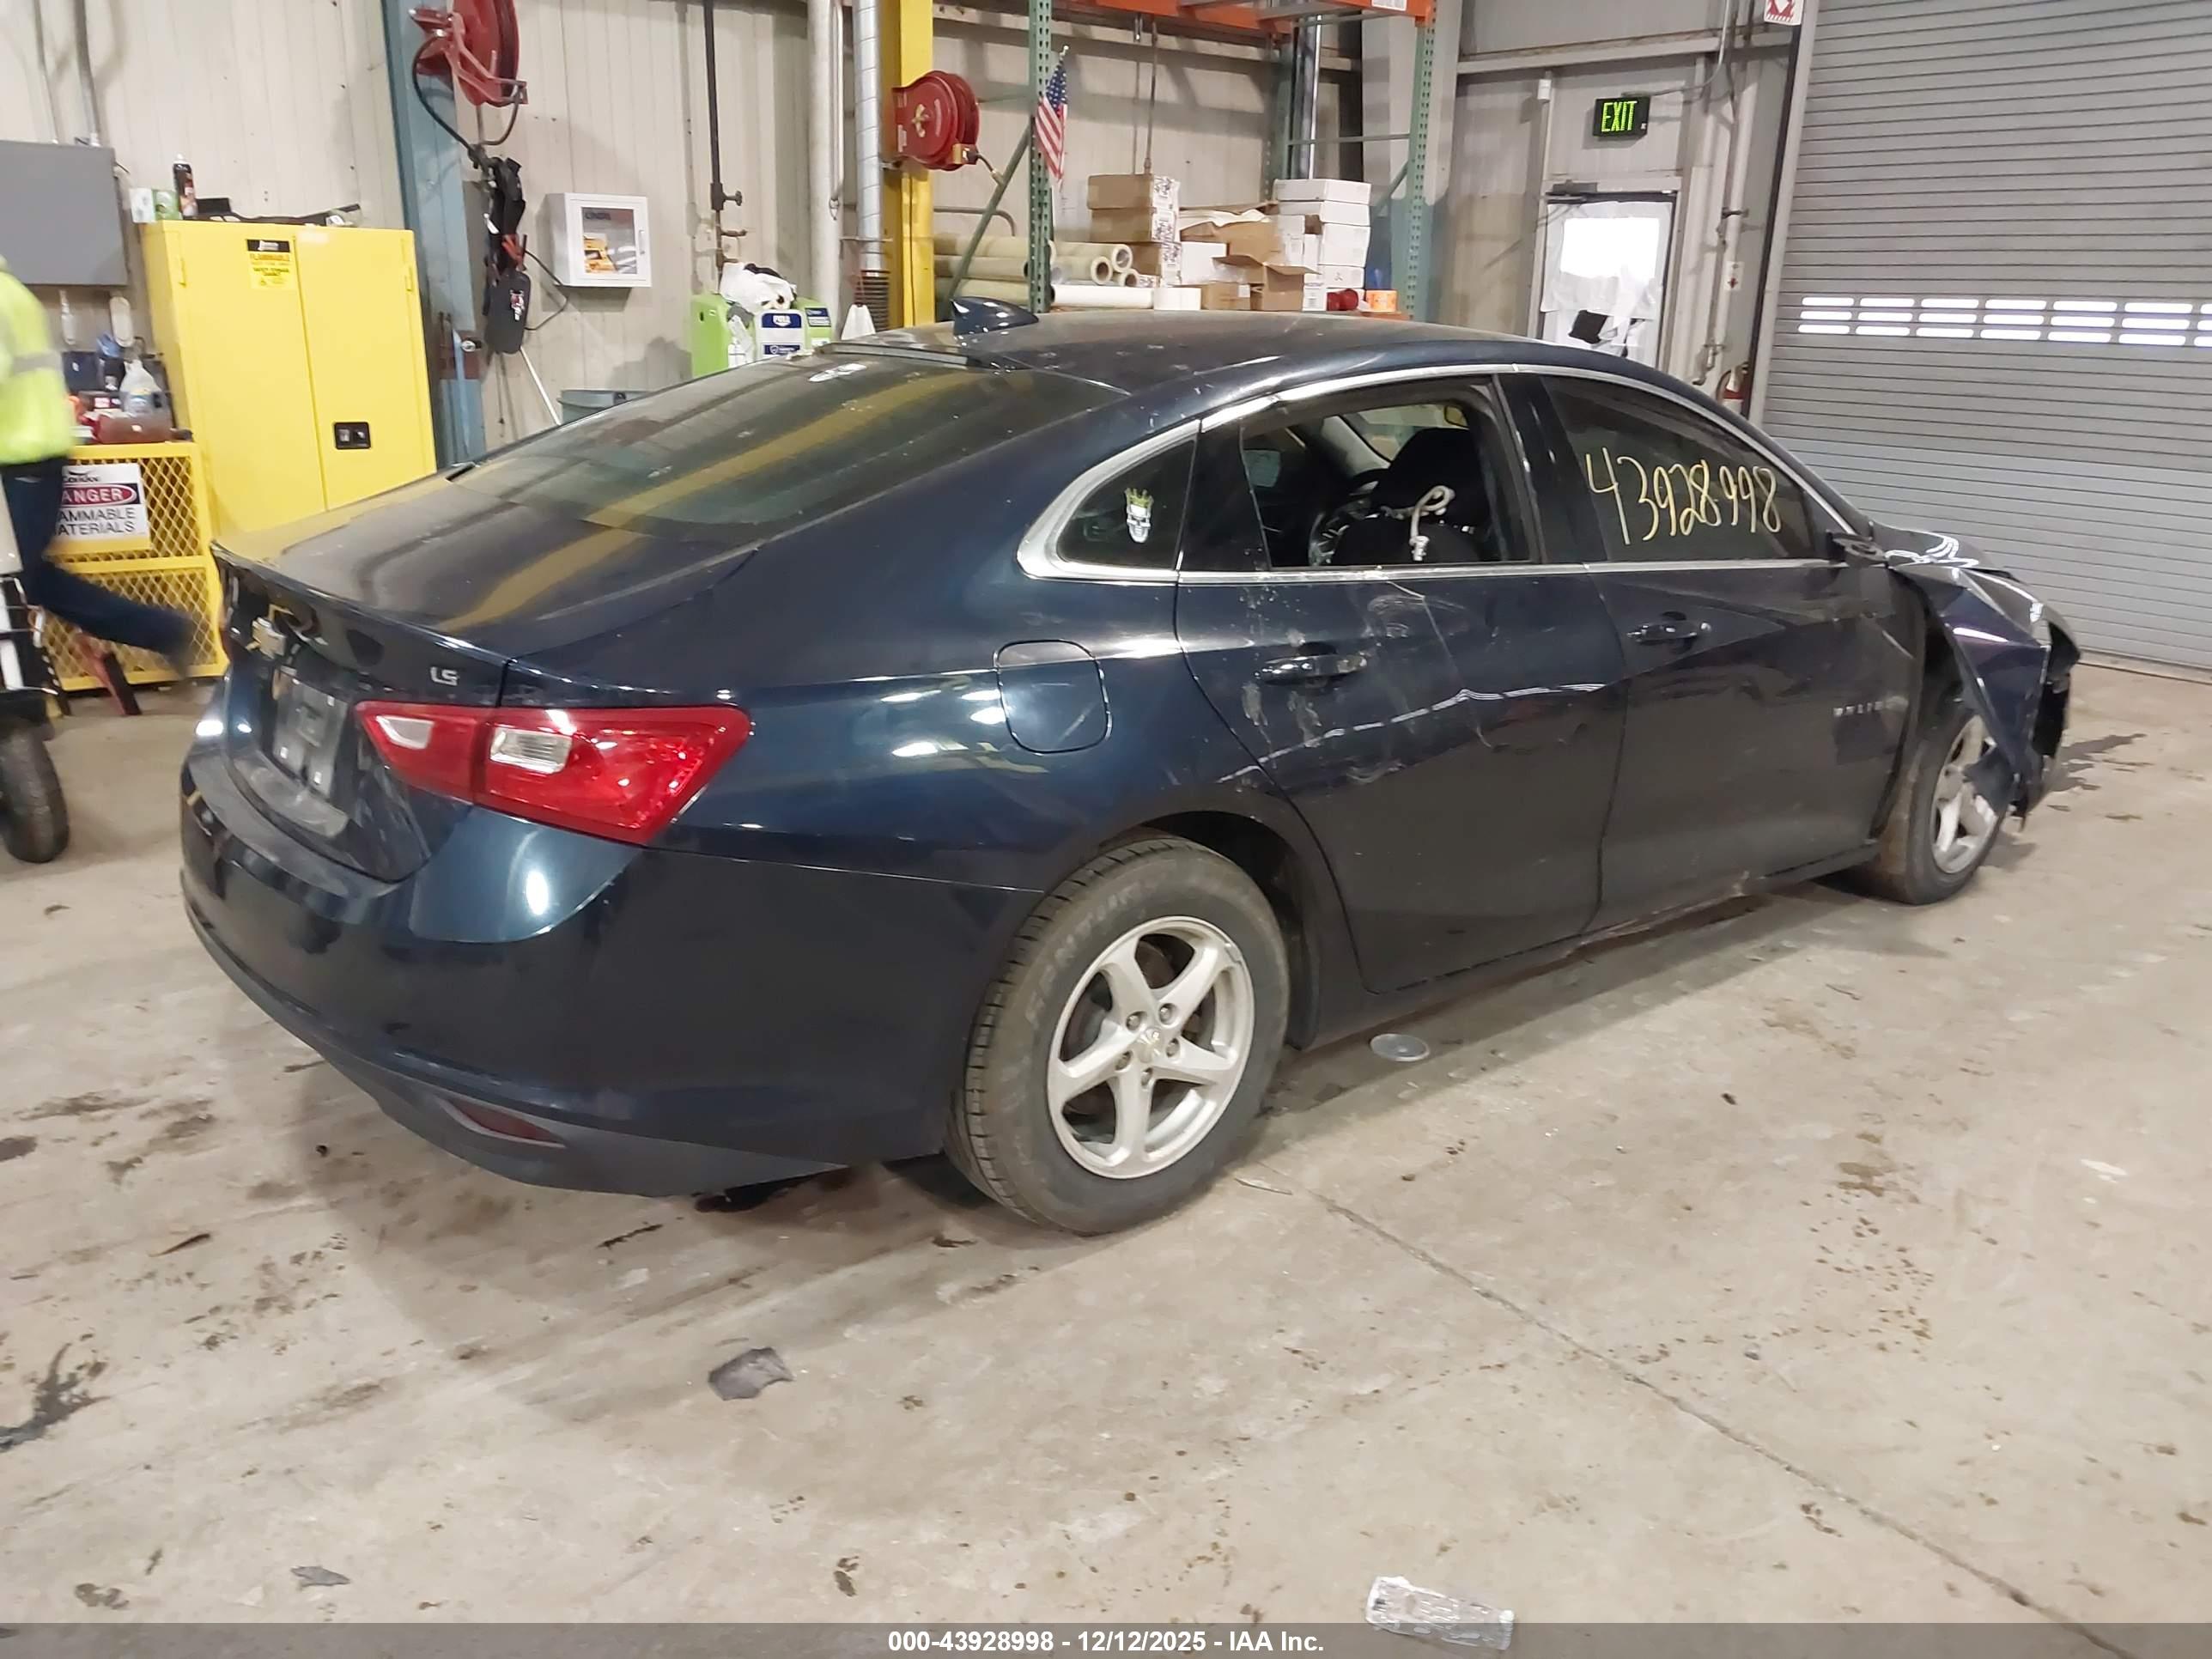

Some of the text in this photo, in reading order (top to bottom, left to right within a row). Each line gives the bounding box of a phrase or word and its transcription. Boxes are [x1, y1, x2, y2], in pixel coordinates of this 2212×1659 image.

[1601, 100, 1638, 132] EXIT
[61, 487, 124, 504] ANGER
[1585, 447, 1782, 545] 43928998
[59, 507, 136, 522] AMMABLE
[58, 520, 135, 536] ATERIALS
[429, 666, 459, 686] LS
